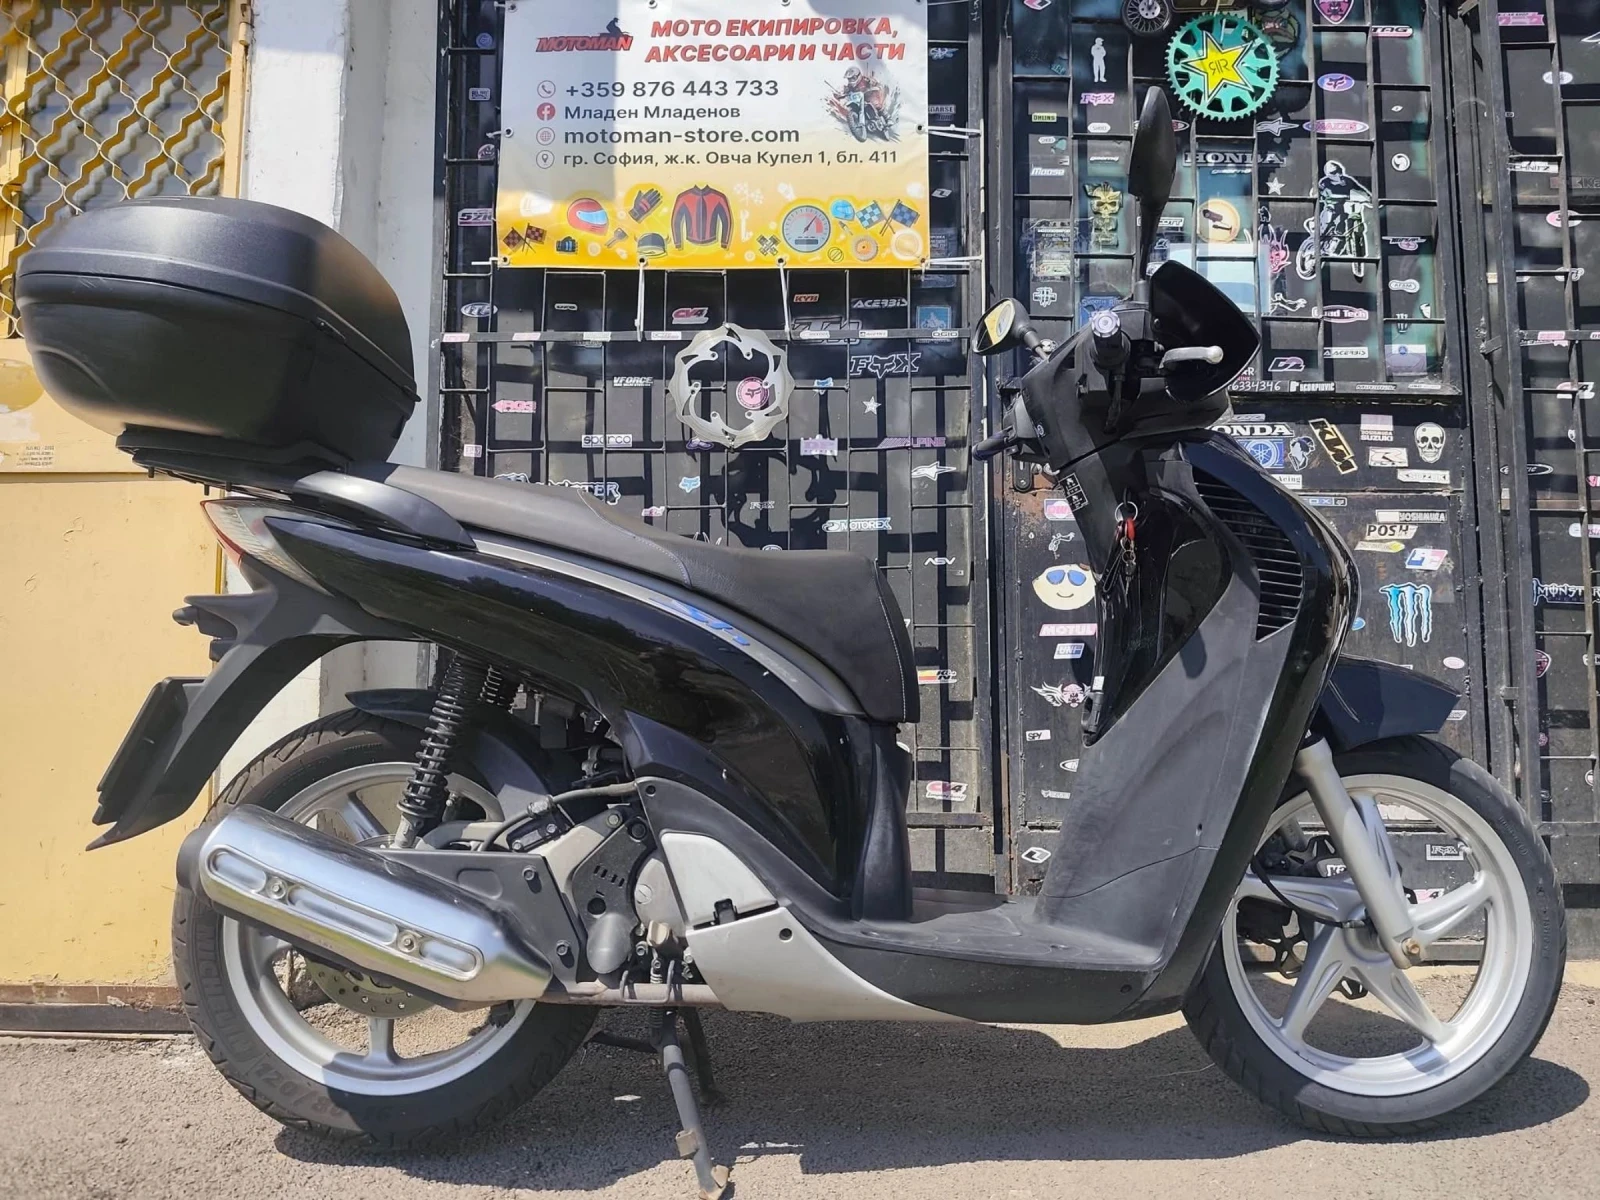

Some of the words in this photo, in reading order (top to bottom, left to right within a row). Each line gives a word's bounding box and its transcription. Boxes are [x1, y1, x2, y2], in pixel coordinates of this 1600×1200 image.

[651, 20, 721, 37] МОТО
[725, 17, 898, 39] ЕКИПИРОВКА,
[536, 35, 633, 52] MOTOMAN
[645, 44, 797, 63] АКСЕСОАРИ
[799, 44, 816, 61] И
[821, 43, 906, 60] ЧАСТИ
[566, 82, 625, 98] +359
[632, 81, 676, 98] 876
[683, 80, 728, 97] 443
[736, 80, 779, 97] 733
[564, 105, 638, 121] Младен
[644, 104, 741, 121] Младенов
[564, 127, 800, 144] motoman-store.com
[563, 154, 588, 169] гр.
[593, 151, 659, 167] София,
[664, 153, 701, 165] ж.к.
[705, 151, 752, 164] Овча
[757, 151, 813, 165] Купел
[818, 150, 831, 166] 1,
[836, 150, 864, 164] бл.
[869, 150, 898, 163] 411
[1184, 152, 1284, 164] HONDA
[1031, 167, 1065, 176] Moose
[1343, 308, 1367, 318] Tech
[613, 376, 653, 384] VFORCE
[1211, 424, 1294, 437] ONDA
[583, 434, 632, 446] sparco
[841, 518, 892, 530] MOTOREX
[1367, 525, 1409, 537] POSH
[1538, 586, 1600, 598] MONSTR
[1042, 624, 1096, 636] MOTUL
[1027, 731, 1043, 740] SPY
